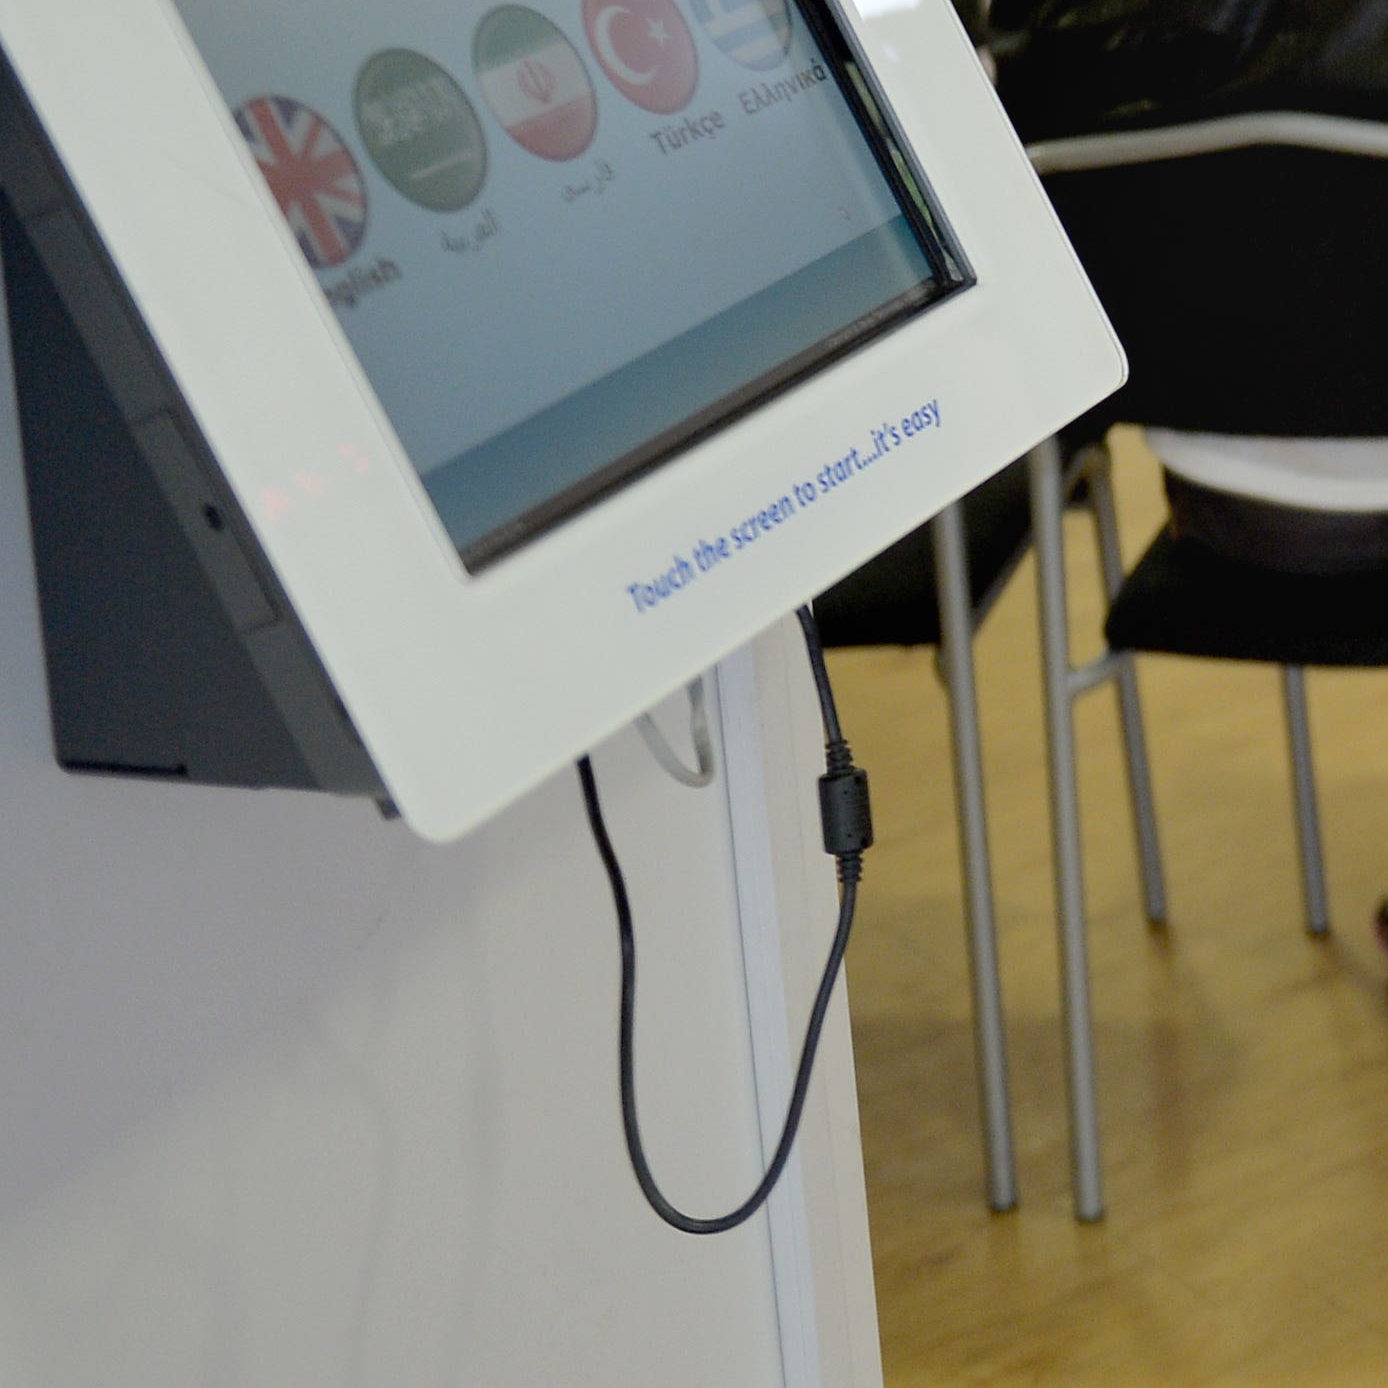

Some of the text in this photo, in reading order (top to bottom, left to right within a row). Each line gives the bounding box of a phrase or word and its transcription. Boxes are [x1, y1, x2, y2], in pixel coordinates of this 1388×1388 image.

[737, 57, 828, 116] Ελληνικά
[649, 108, 727, 156] Türkçe
[626, 555, 697, 613] Touch
[692, 539, 731, 573] the
[729, 494, 797, 550] screen
[791, 480, 819, 508] to
[899, 398, 943, 438] easy
